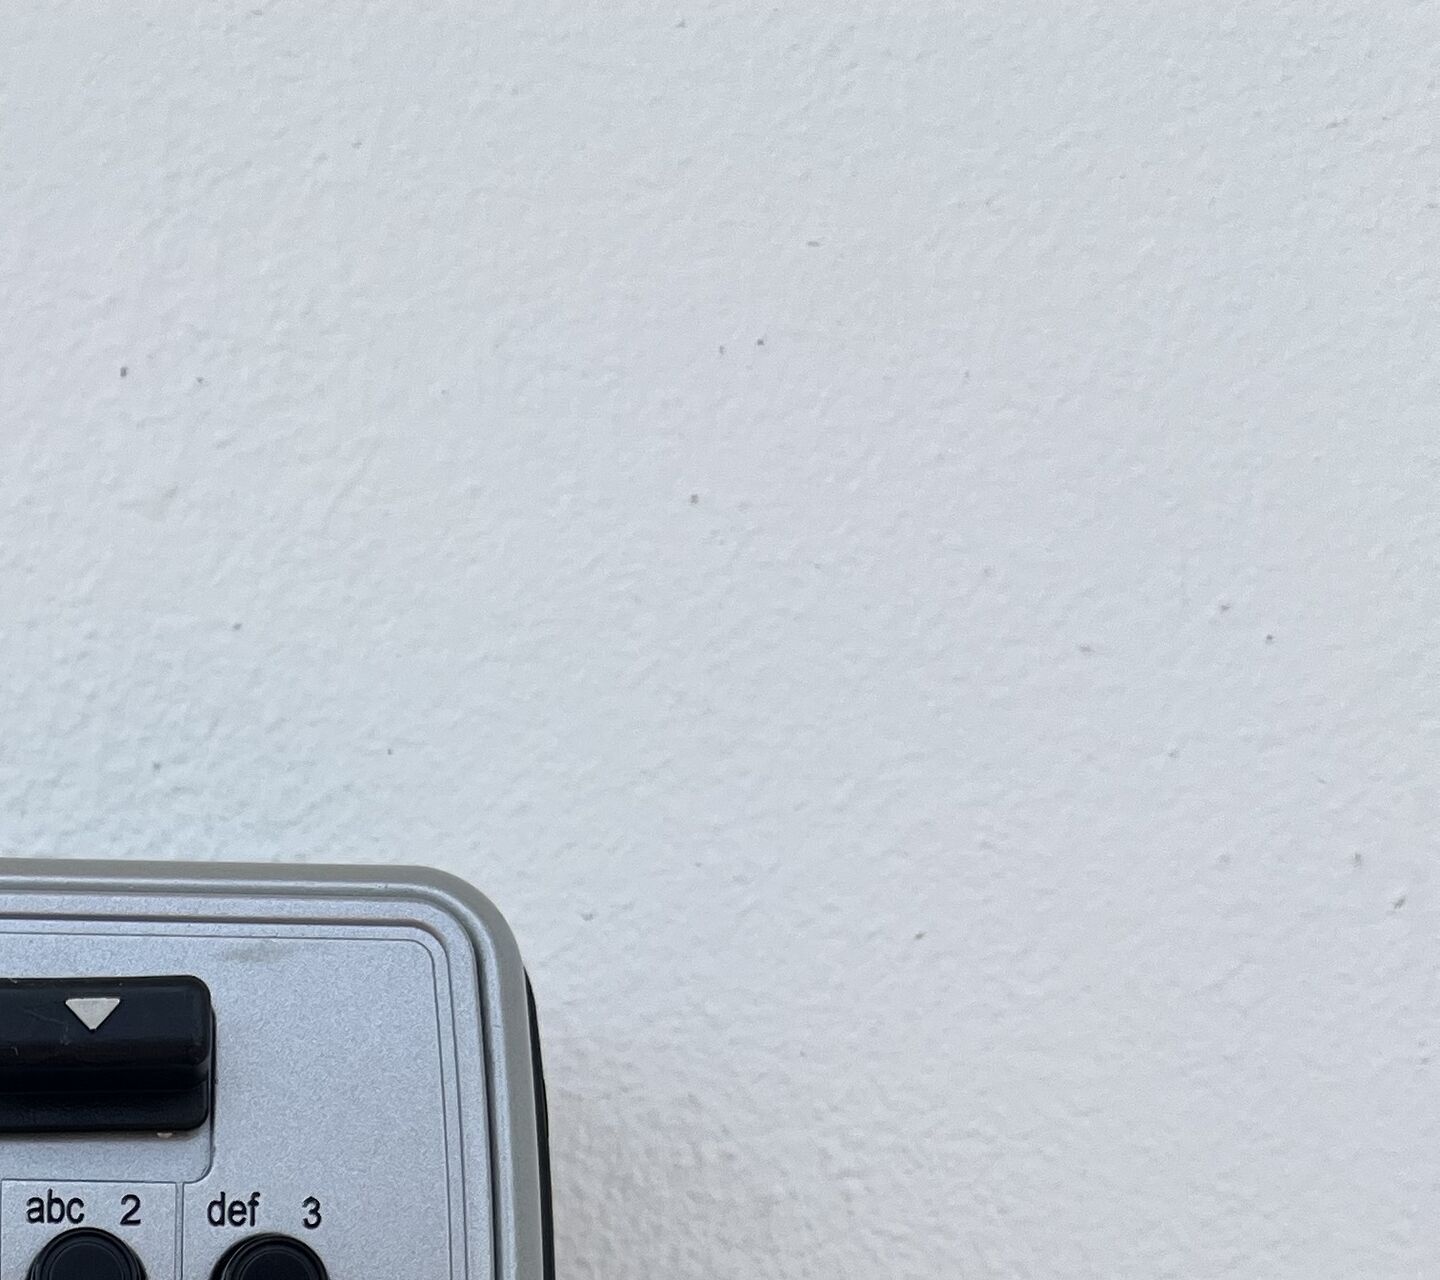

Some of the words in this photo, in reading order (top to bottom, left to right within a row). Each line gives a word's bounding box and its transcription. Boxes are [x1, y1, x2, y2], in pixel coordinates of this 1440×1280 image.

[26, 1189, 85, 1225] abc
[119, 1193, 142, 1226] 2
[206, 1191, 261, 1228] def
[302, 1195, 322, 1229] 3
